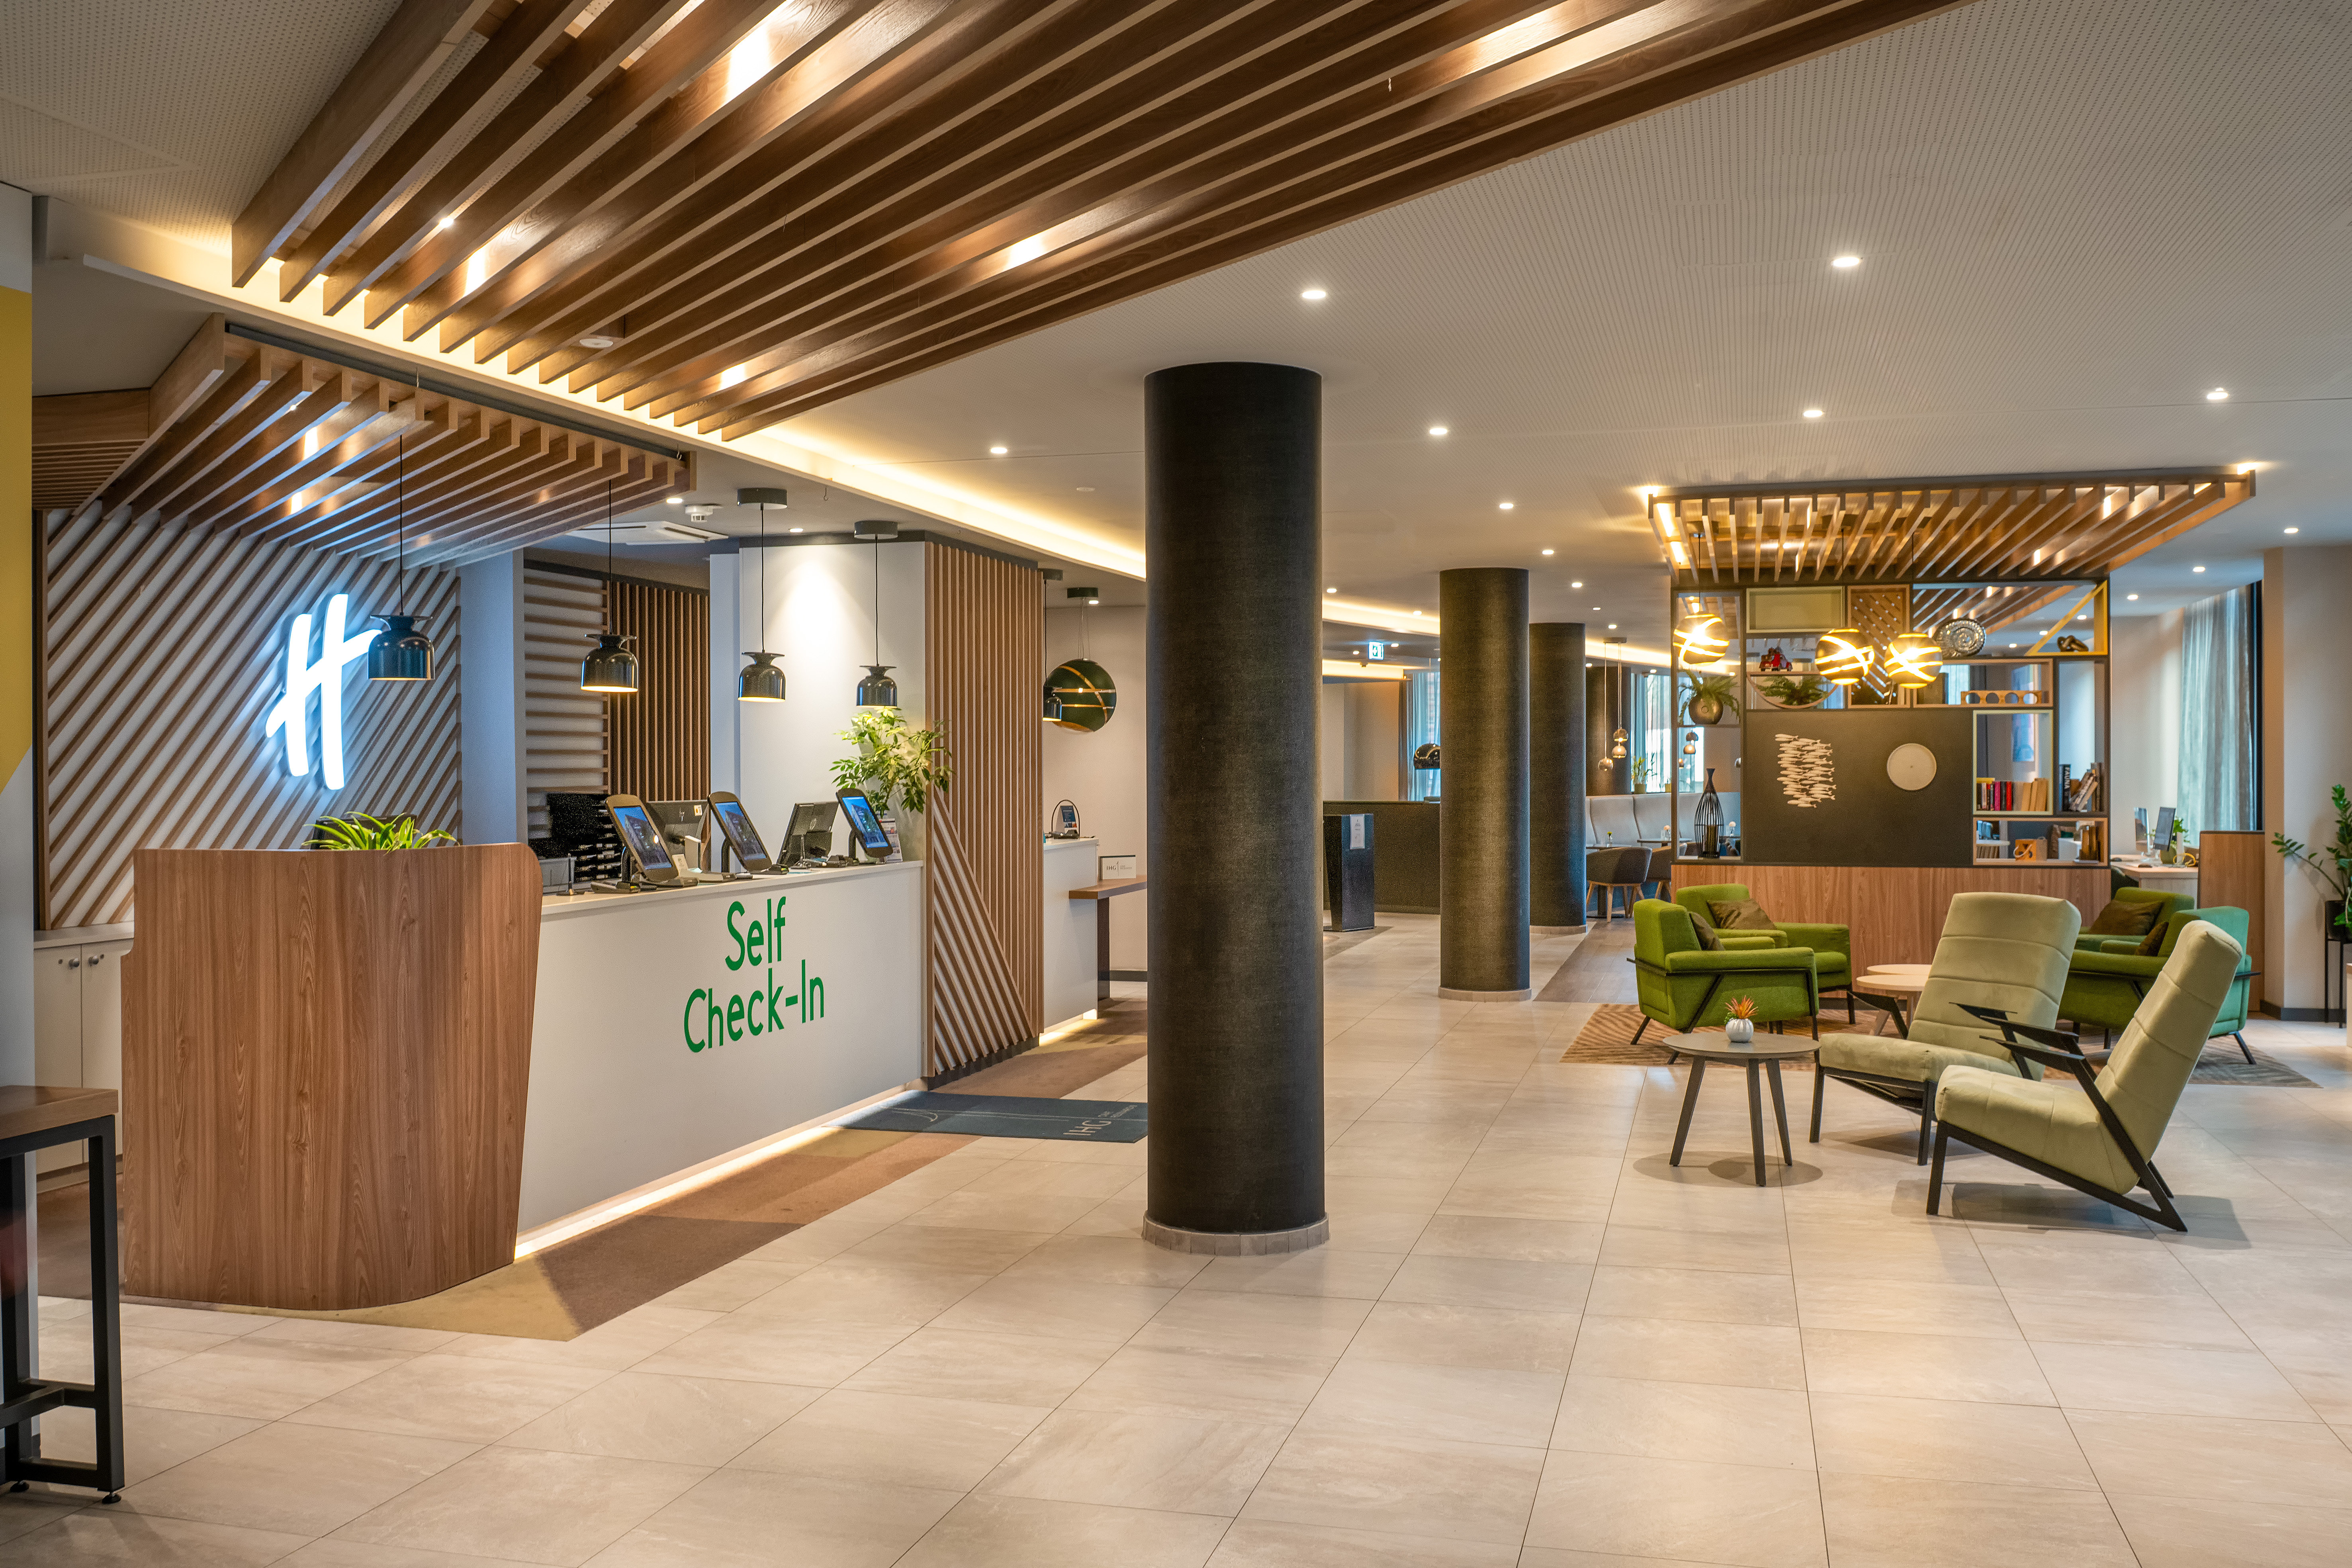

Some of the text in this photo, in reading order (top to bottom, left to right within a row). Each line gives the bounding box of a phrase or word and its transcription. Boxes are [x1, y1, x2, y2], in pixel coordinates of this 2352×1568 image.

[266, 593, 383, 790] H
[725, 896, 786, 971] Self
[684, 959, 824, 1053] Check-In
[1063, 1120, 1111, 1136] IHG
